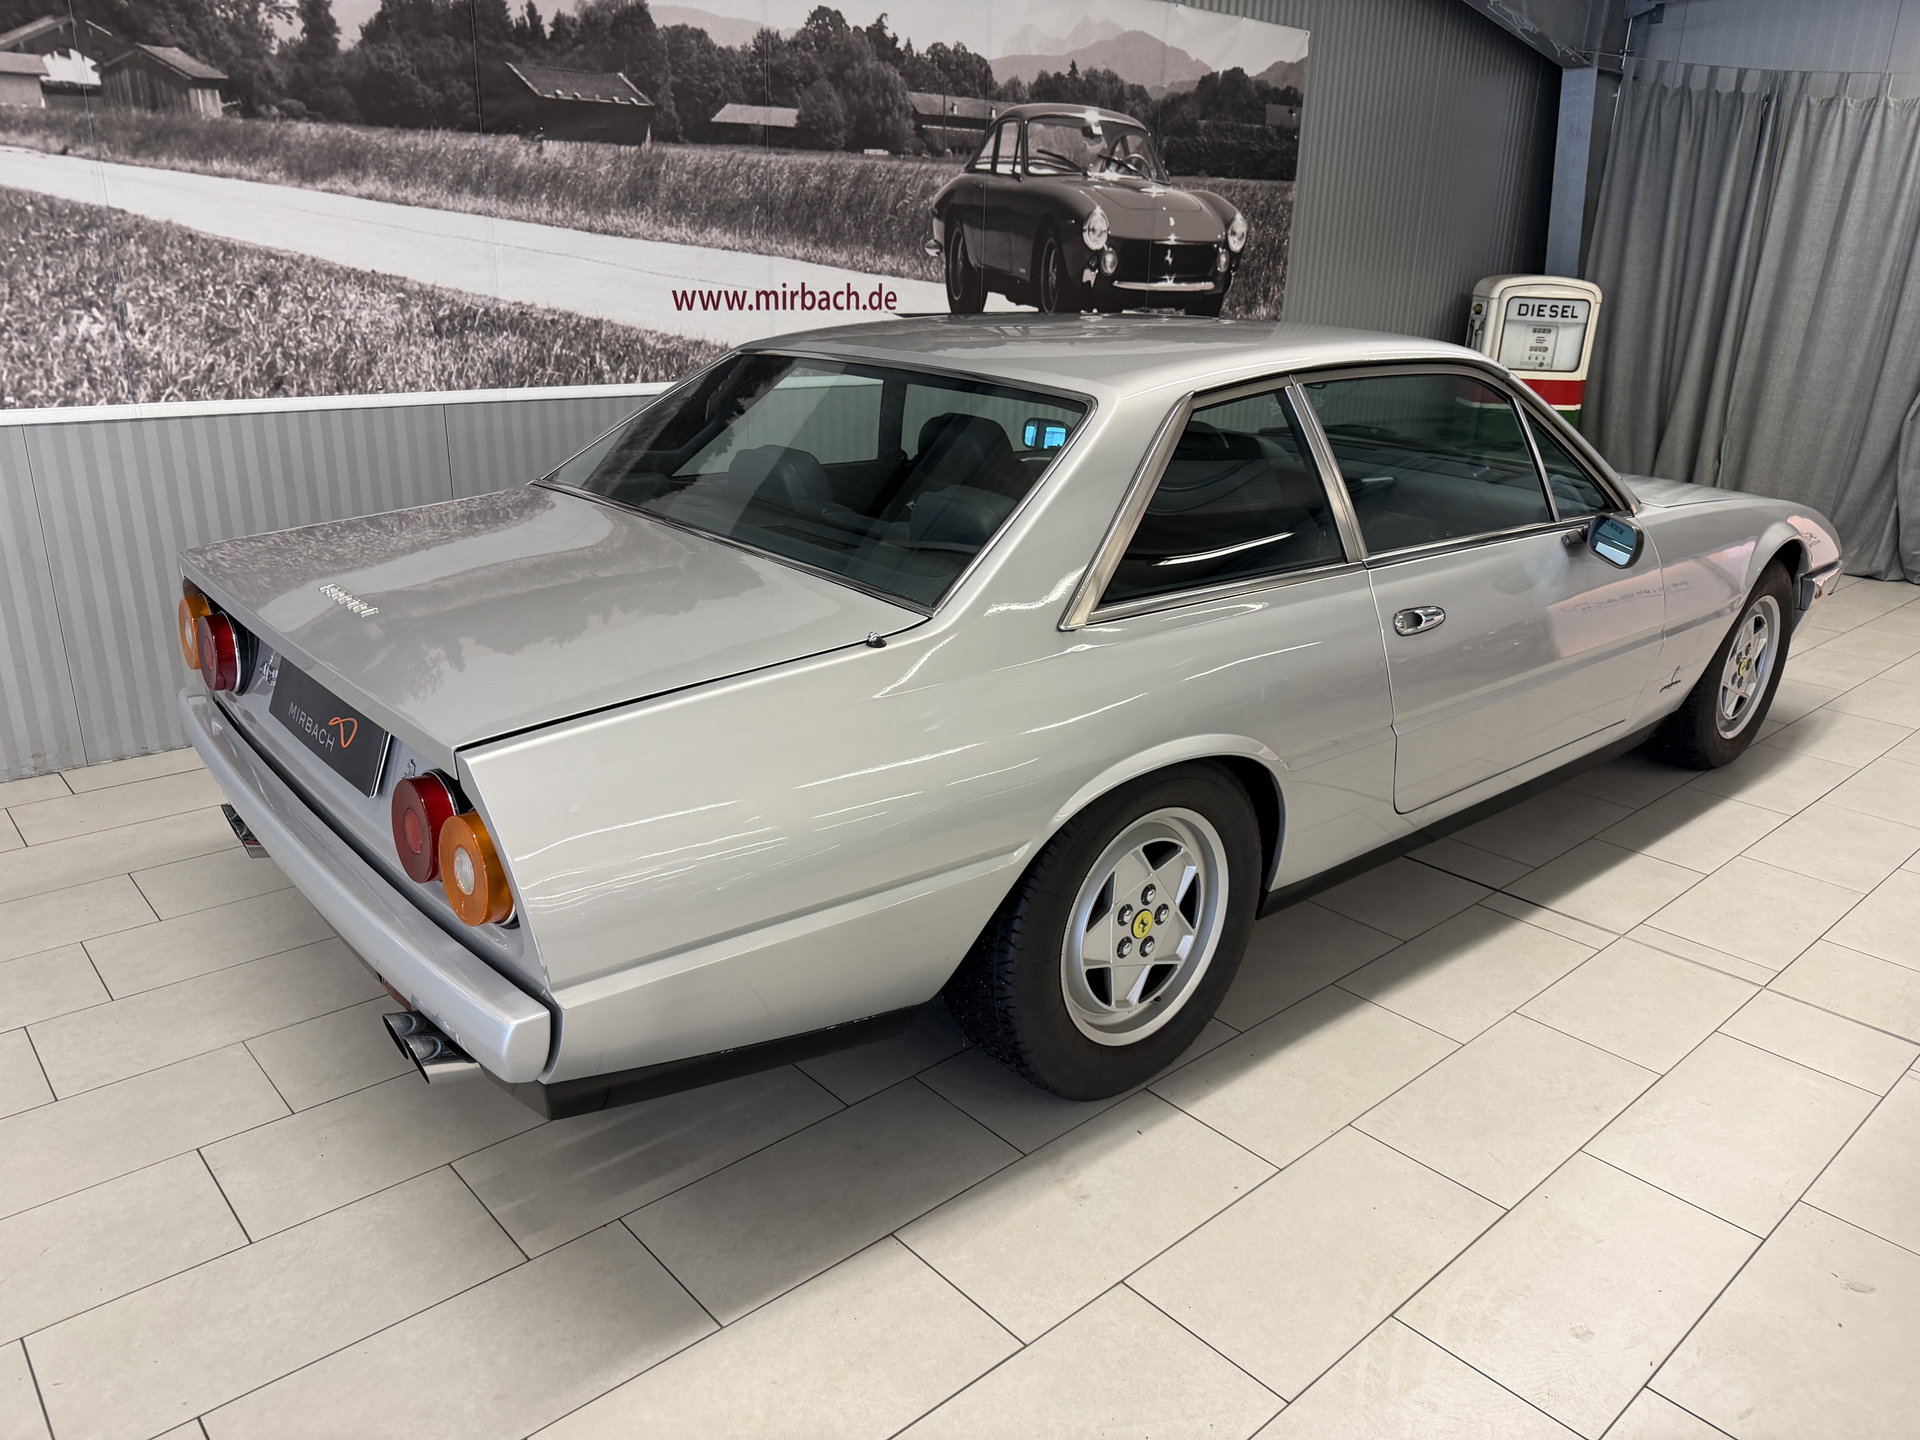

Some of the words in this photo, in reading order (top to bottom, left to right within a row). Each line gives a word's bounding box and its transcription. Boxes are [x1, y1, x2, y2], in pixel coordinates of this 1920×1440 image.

[671, 282, 898, 311] www.mirbach.de
[1517, 303, 1579, 319] DIESEL
[288, 702, 336, 751] MIRBACH
